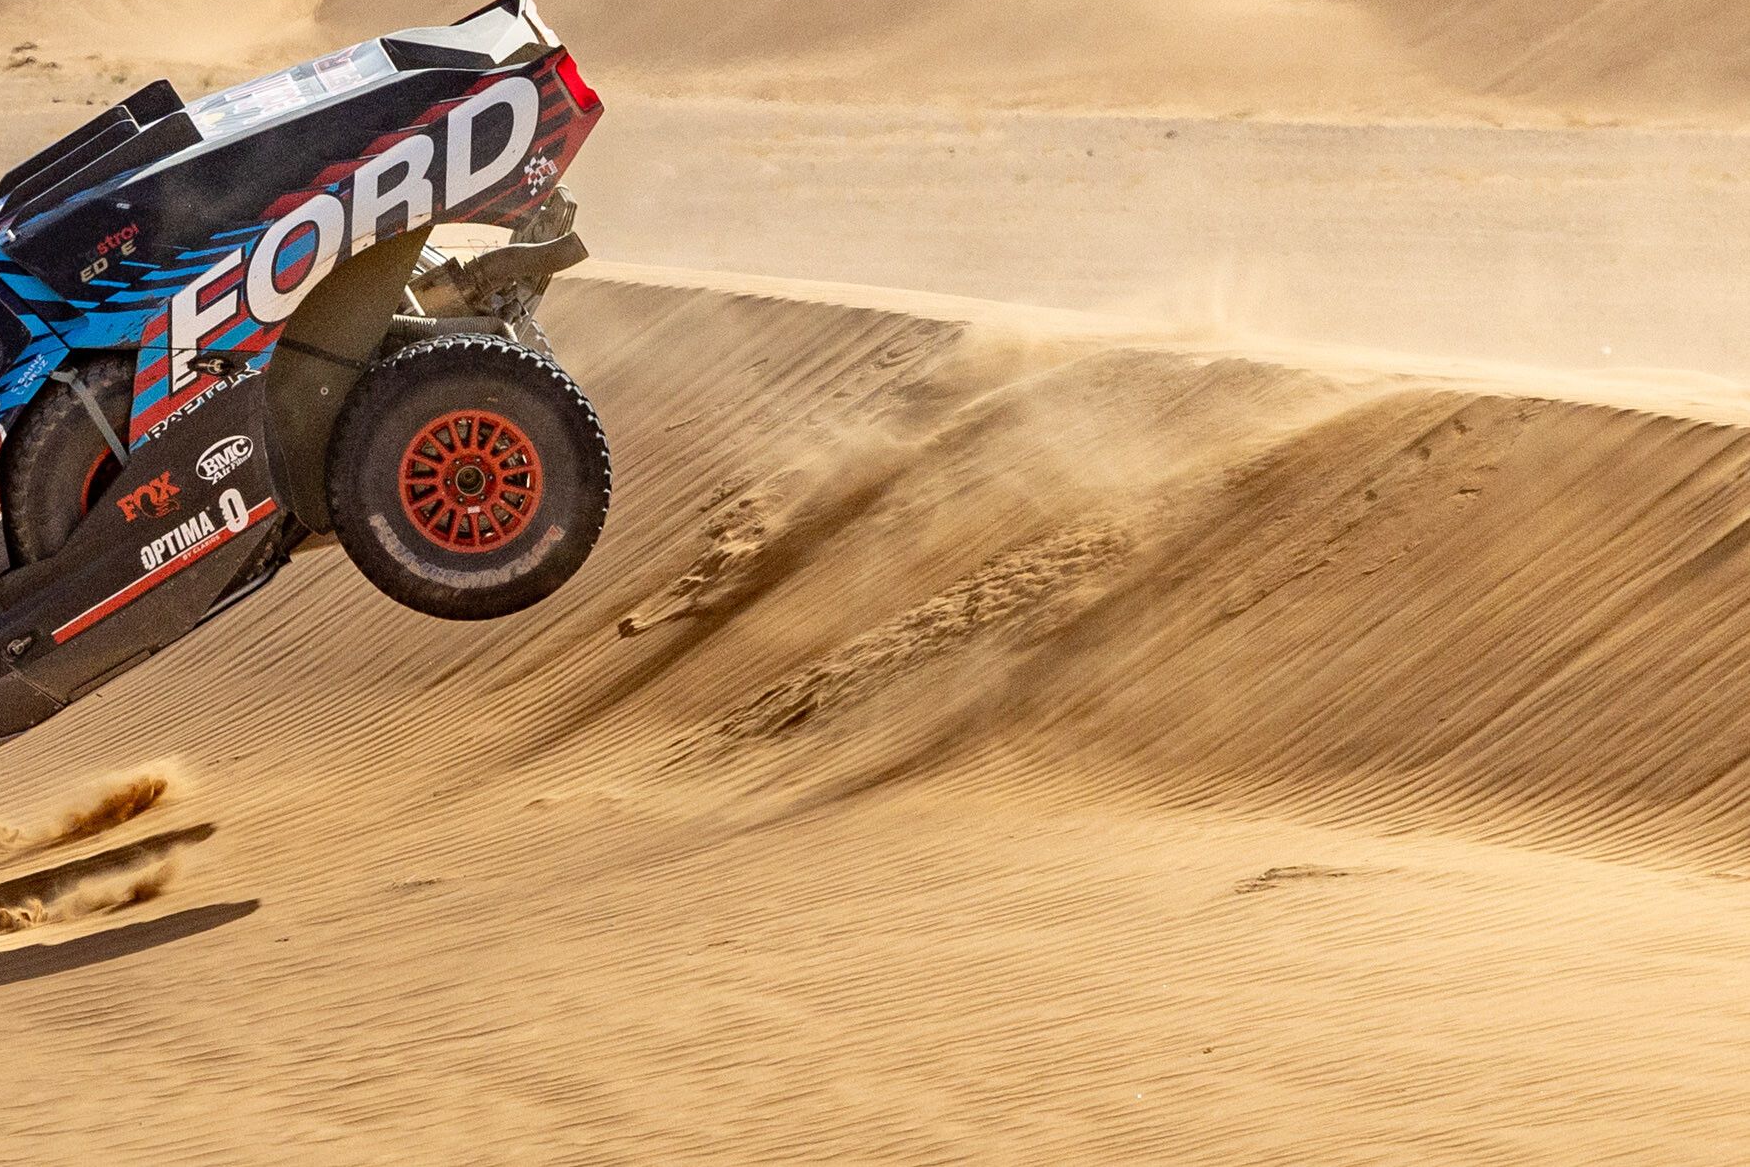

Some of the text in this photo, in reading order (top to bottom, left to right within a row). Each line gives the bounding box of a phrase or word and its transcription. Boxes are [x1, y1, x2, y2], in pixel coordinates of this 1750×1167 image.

[170, 77, 540, 394] FORD
[80, 238, 137, 283] EDE
[201, 438, 249, 476] BMC
[212, 466, 231, 485] Air
[116, 471, 181, 522] FOX
[140, 510, 215, 571] OPTIMA
